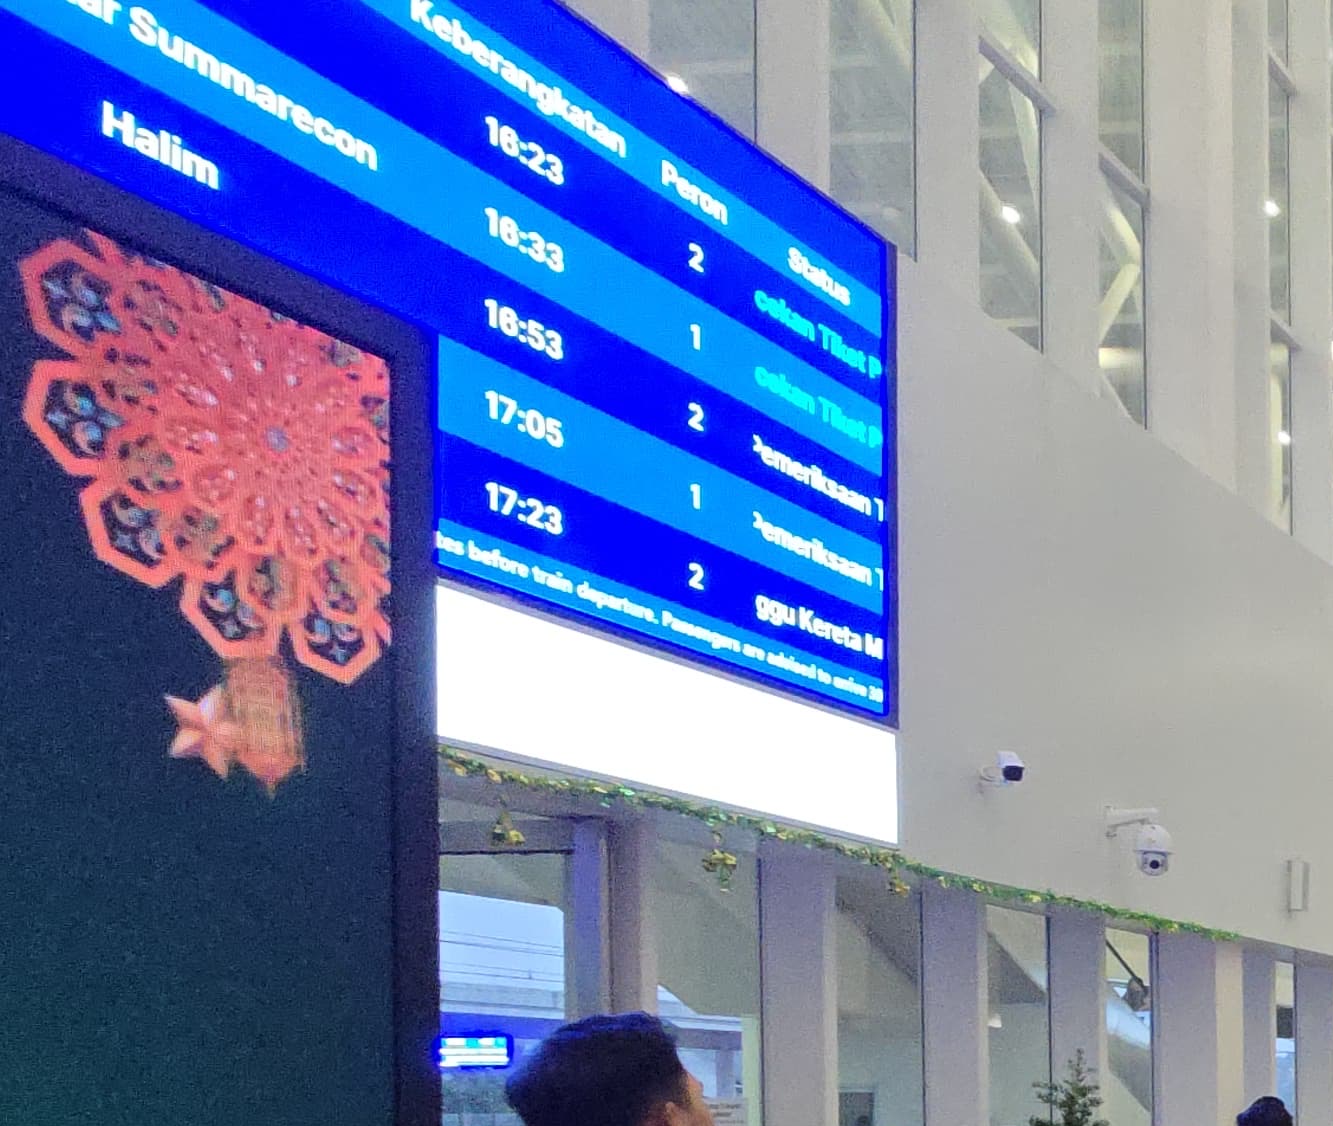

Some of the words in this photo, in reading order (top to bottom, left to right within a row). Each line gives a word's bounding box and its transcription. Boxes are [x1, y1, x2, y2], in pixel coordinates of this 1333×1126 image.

[129, 6, 378, 171] Summarecon
[102, 100, 219, 190] Halim
[411, 0, 626, 158] Keberangkatan
[662, 160, 728, 225] Peron
[787, 247, 850, 306] Status
[485, 115, 564, 185] 16:23
[484, 206, 564, 272] 16:33
[688, 243, 704, 273] 2
[484, 298, 563, 360] 16:53
[690, 324, 701, 350] 1
[818, 323, 866, 374] Tiket
[484, 390, 564, 448] 17:05
[688, 402, 704, 431] 2
[484, 482, 563, 535] 17:23
[690, 483, 701, 510] 1
[688, 562, 704, 590] 2
[467, 540, 529, 578] before
[532, 565, 573, 593] train
[576, 581, 659, 624] departure.
[661, 610, 741, 653] Passengers
[742, 643, 766, 662] are
[766, 652, 817, 680] advised
[817, 668, 832, 685] to
[832, 677, 867, 697] arrive
[755, 594, 796, 626] ggu
[798, 606, 862, 653] Kereta
